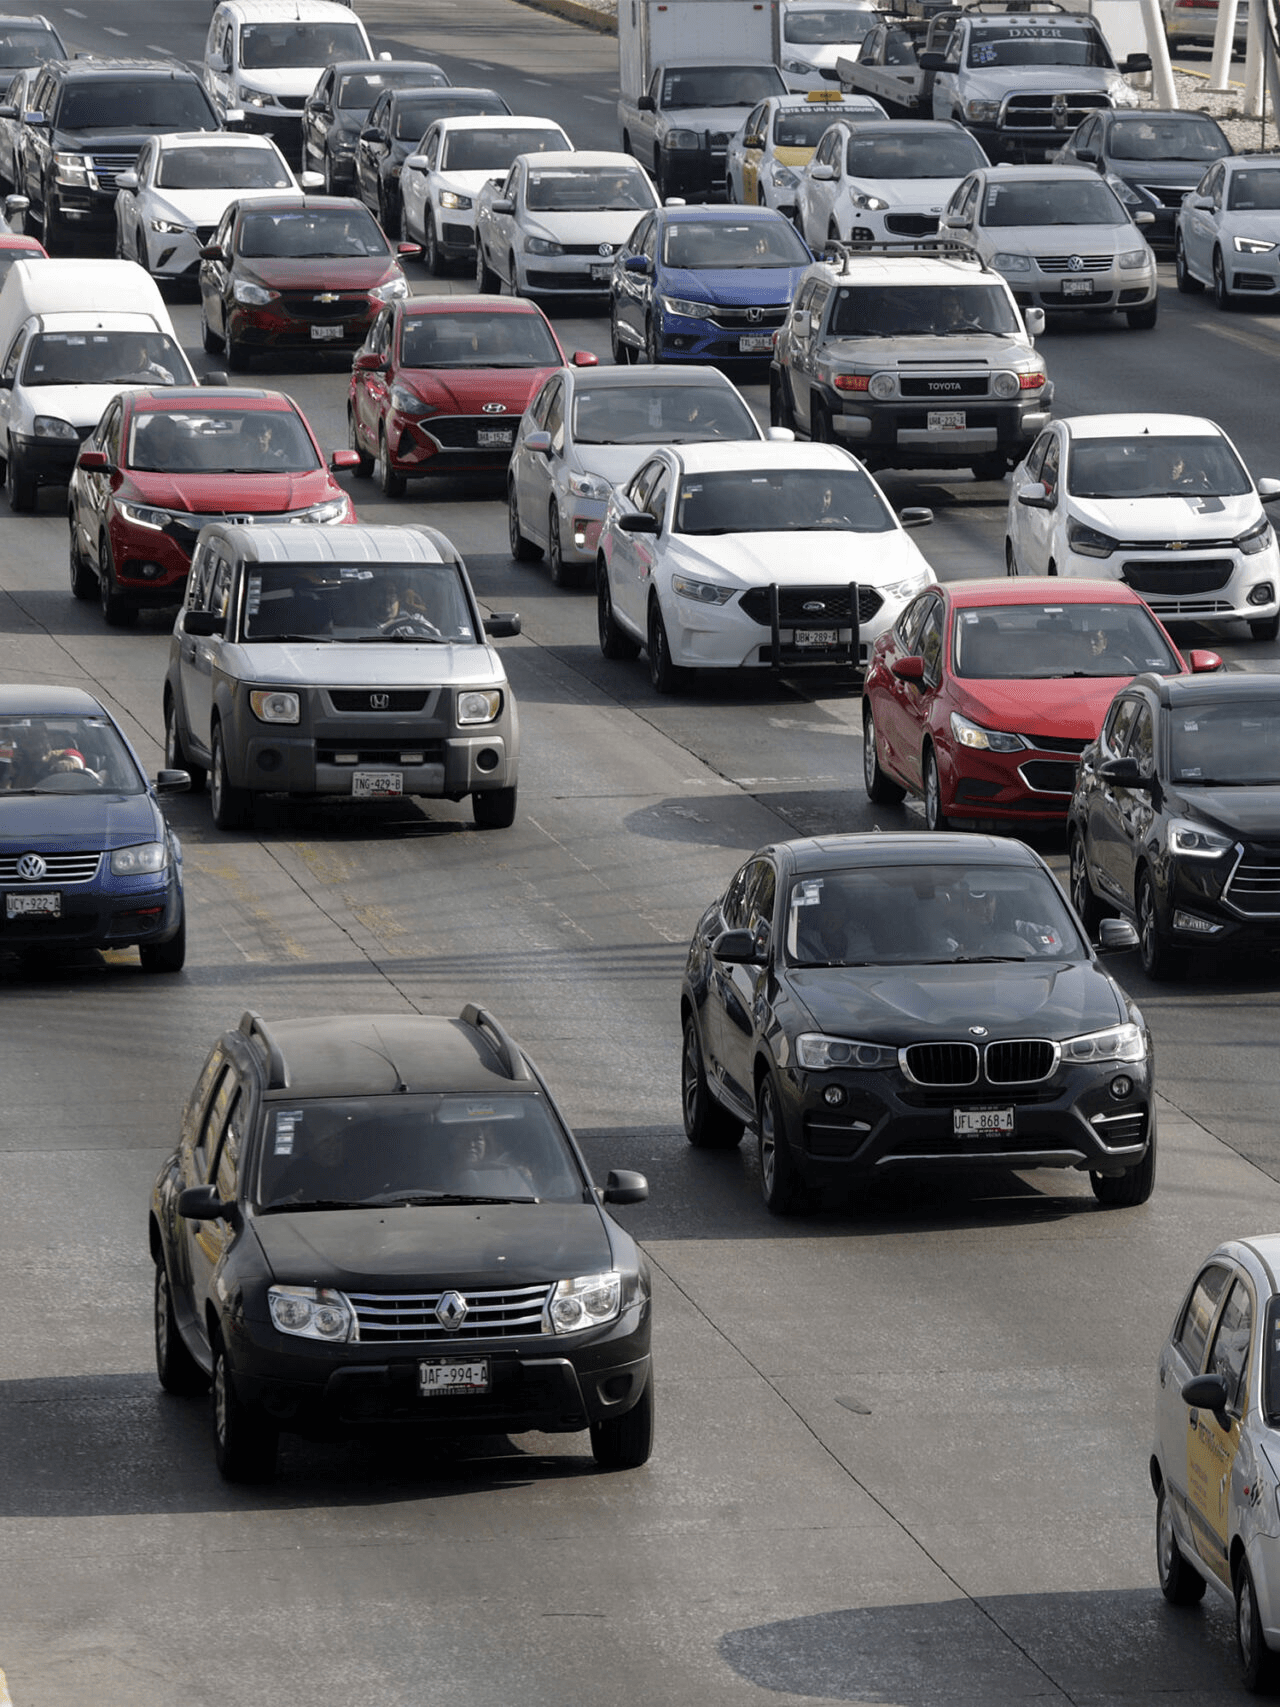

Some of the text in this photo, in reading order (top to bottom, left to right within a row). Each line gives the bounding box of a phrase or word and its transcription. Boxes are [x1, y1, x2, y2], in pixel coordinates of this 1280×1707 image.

[1008, 28, 1063, 38] DAYER
[928, 382, 962, 391] TOYOTA
[355, 778, 402, 790] TNG-429-B
[7, 898, 61, 911] UCY-922-A
[954, 1113, 1013, 1129] UFL-868-A
[420, 1366, 488, 1385] UAF-994-A
